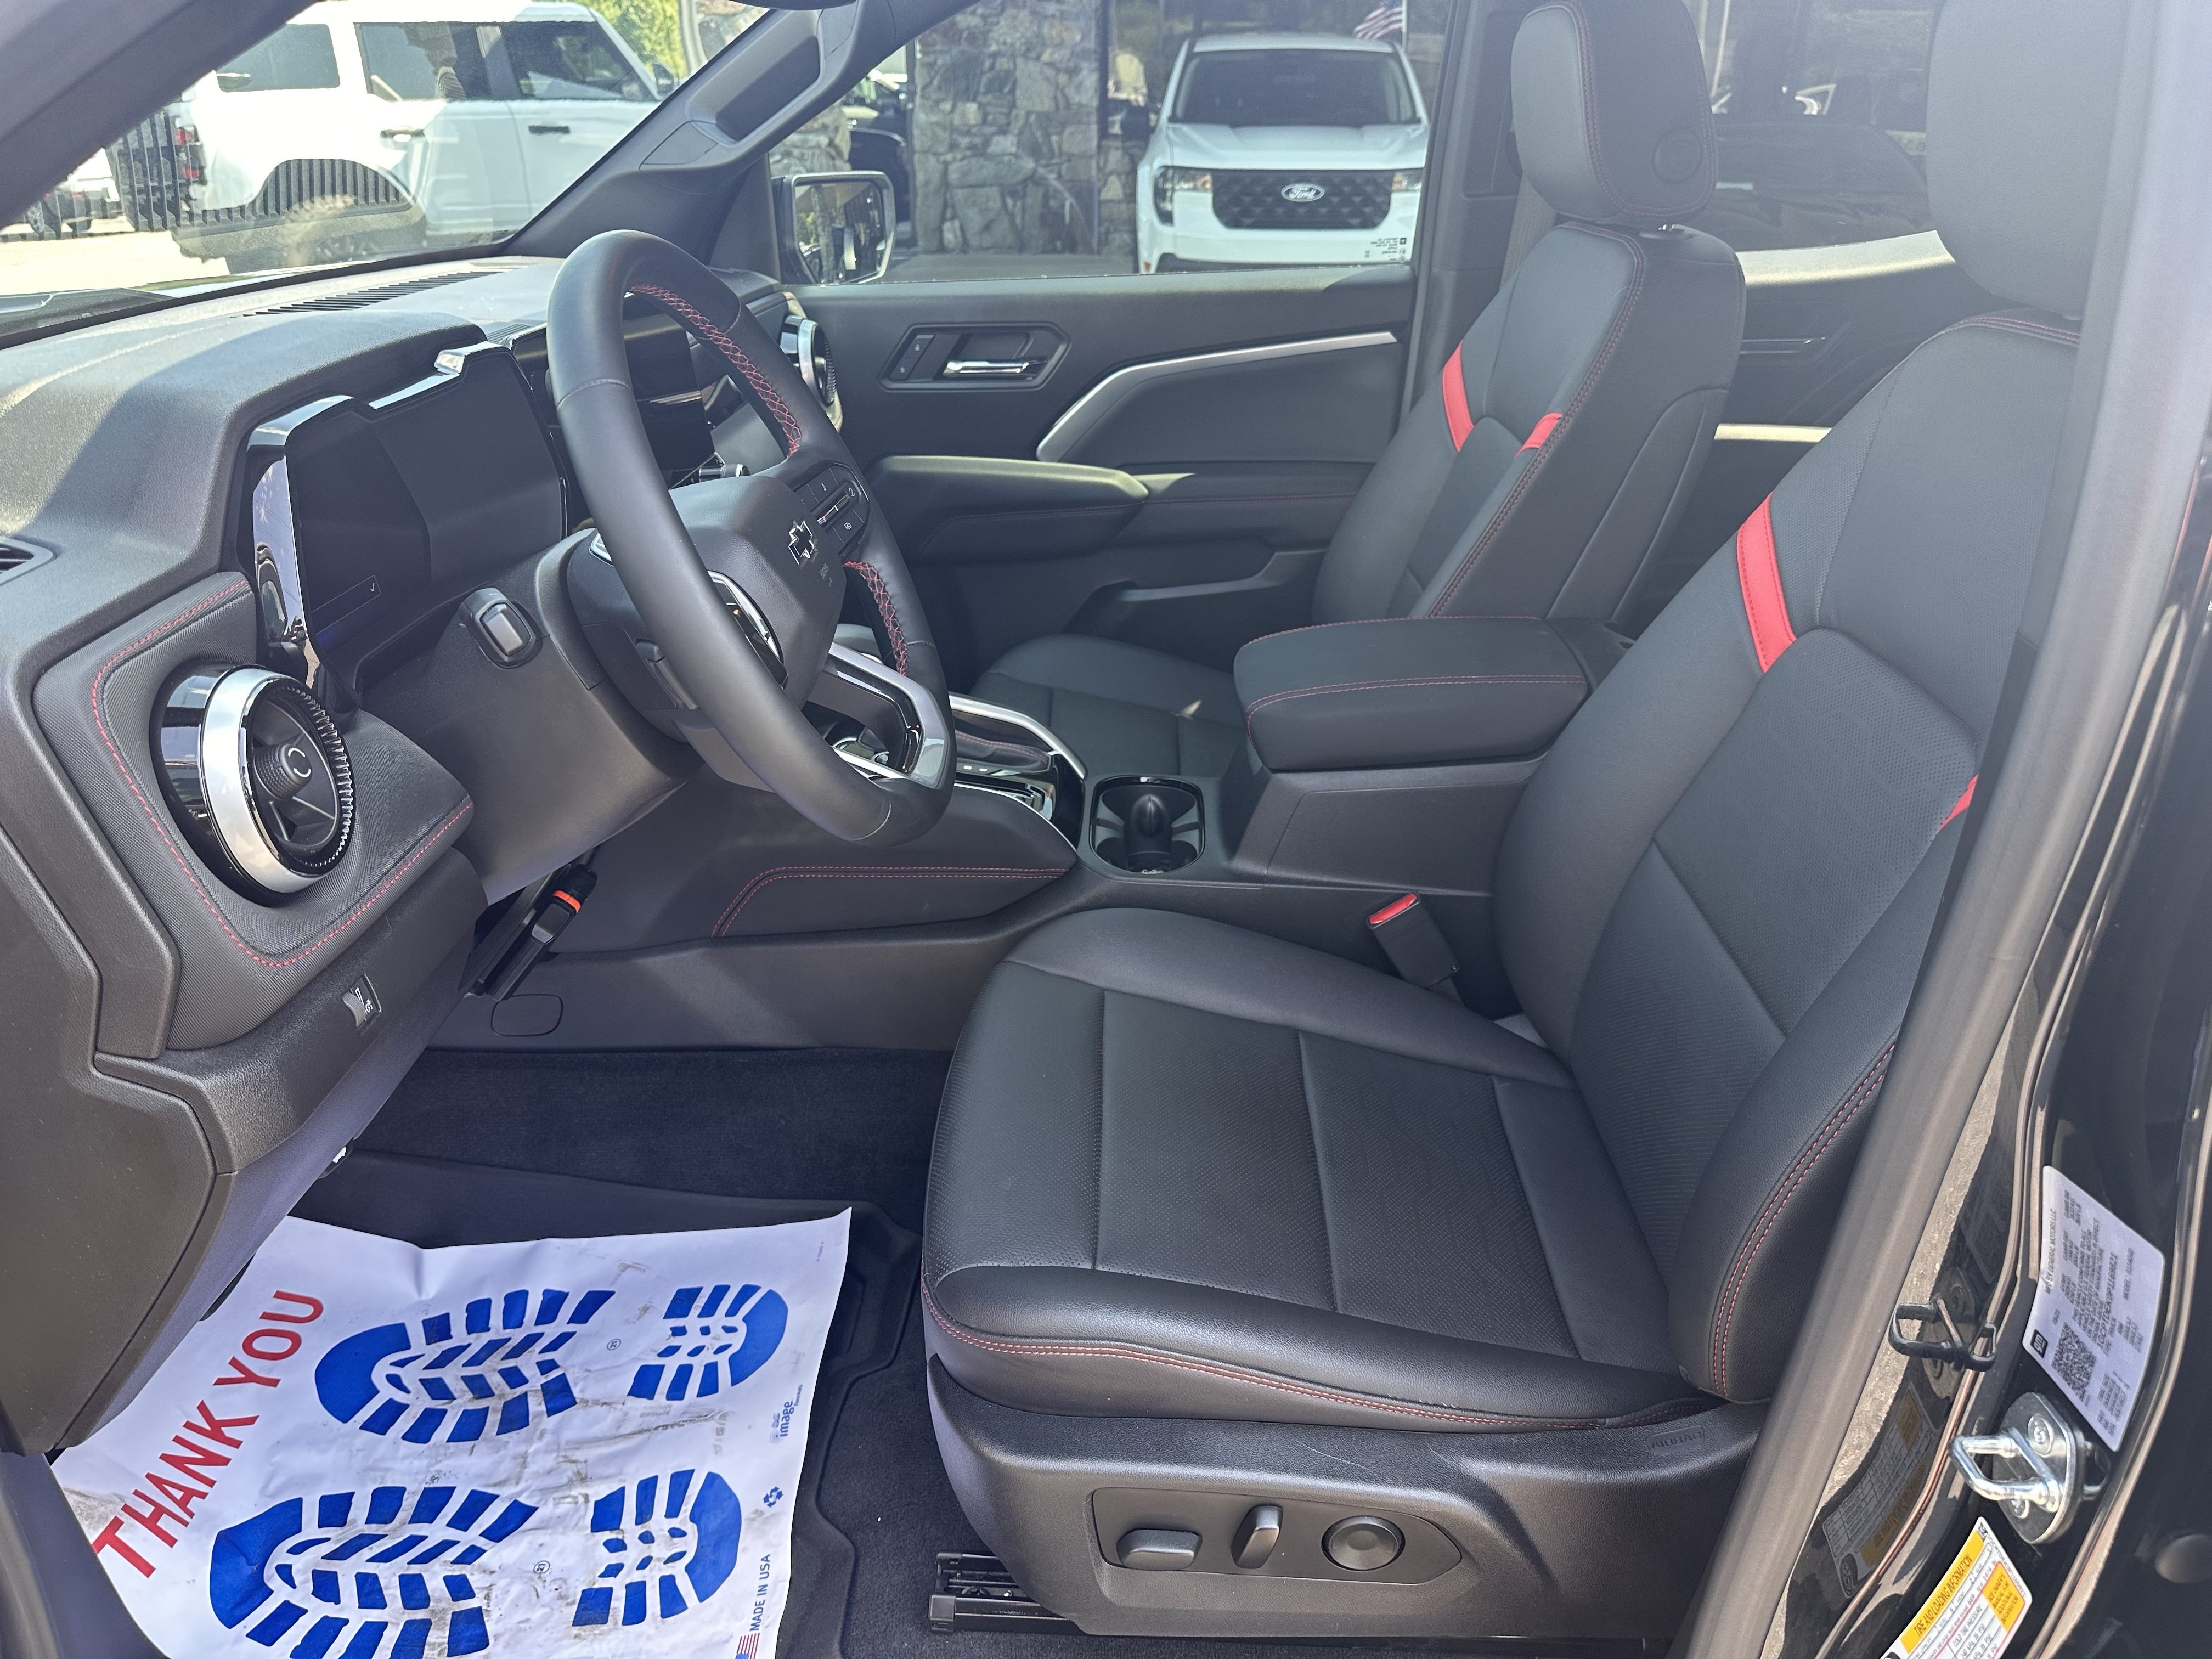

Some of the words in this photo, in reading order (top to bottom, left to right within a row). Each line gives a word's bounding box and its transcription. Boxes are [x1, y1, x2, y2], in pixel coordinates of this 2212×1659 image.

[2045, 1270, 2052, 1284] BY
[793, 1384, 803, 1406] floormats
[776, 1401, 794, 1437] image
[92, 1400, 259, 1578] THANK
[213, 1290, 324, 1388] YOU
[1651, 1431, 1703, 1449] AIRBAG
[759, 1554, 770, 1579] USA
[757, 1584, 768, 1595] IN
[1914, 1619, 1926, 1637] TIRE
[1922, 1608, 1935, 1626] AND
[1931, 1585, 1951, 1615] LOADING
[1946, 1553, 1972, 1593] INFORMATION
[749, 1600, 765, 1630] MADE
[1952, 1632, 1963, 1649] COLD
[1966, 1603, 1982, 1628] PRESSURE
